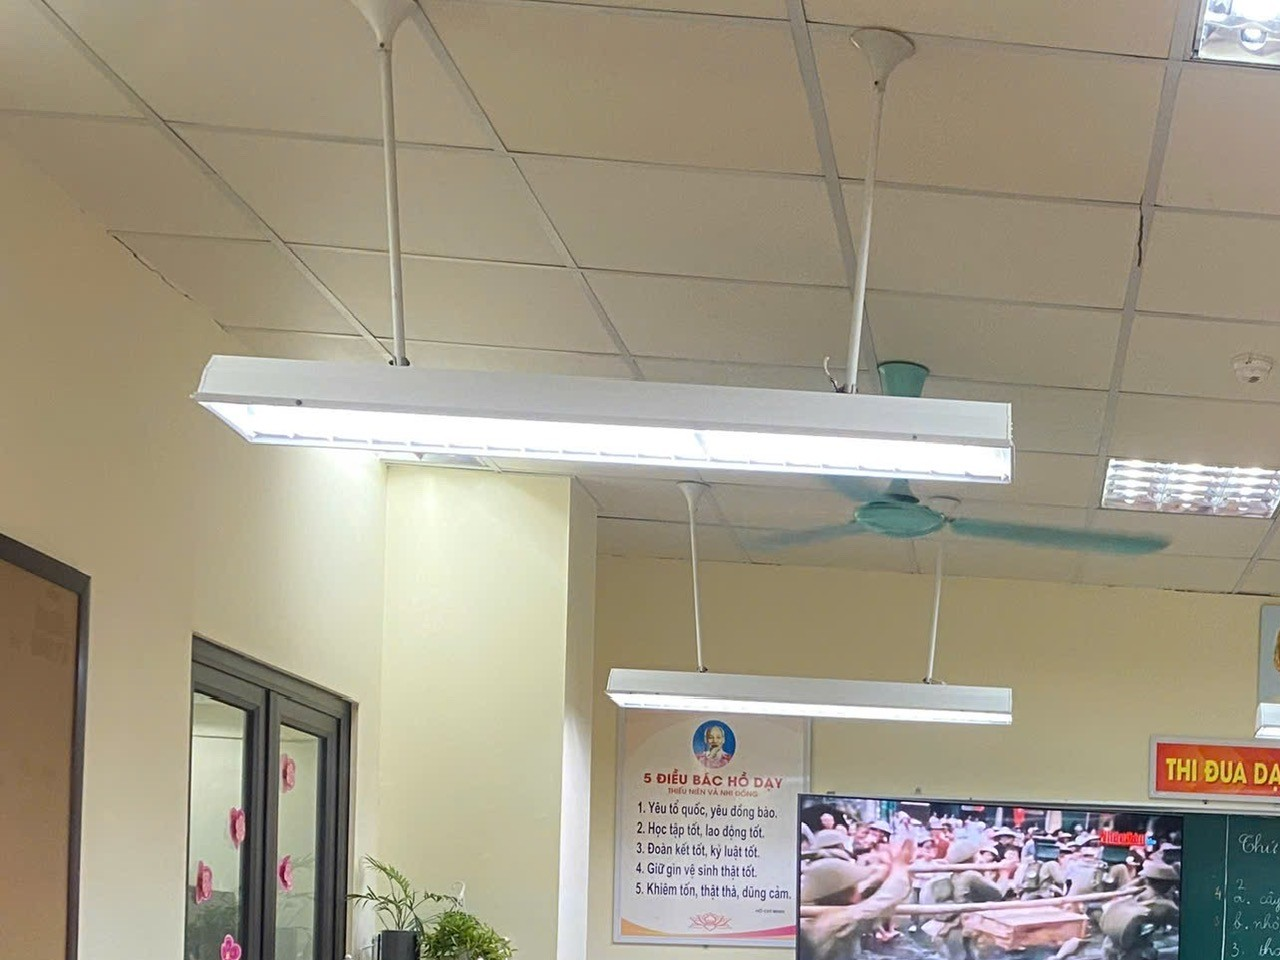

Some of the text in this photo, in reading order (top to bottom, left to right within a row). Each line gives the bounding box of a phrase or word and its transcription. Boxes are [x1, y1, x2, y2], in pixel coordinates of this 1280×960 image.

[1166, 758, 1197, 782] THI
[1204, 759, 1247, 784] ĐUA
[643, 773, 651, 784] 5
[692, 772, 723, 787] BÁC
[754, 777, 783, 792] DẠY
[638, 801, 646, 814] 1.
[649, 801, 667, 814] Yêu
[681, 802, 708, 818] quốc,
[710, 804, 728, 819] yêu
[636, 821, 765, 840] 2. Học tập tốt, lao động tốt.
[636, 842, 644, 854] 3.
[647, 842, 673, 855] Đoàn
[676, 843, 690, 855] kết
[692, 843, 708, 858] tốt,
[724, 844, 742, 860] luật
[744, 844, 760, 859] tốt.
[636, 862, 644, 874] 4.
[647, 862, 665, 875] Giữ
[685, 863, 695, 879] vệ
[698, 864, 719, 877] sinh
[721, 865, 740, 880] thật
[742, 864, 757, 878] tốt.
[635, 882, 644, 895] 5.
[647, 882, 677, 896] Khiêm
[680, 881, 698, 898] tốn,
[701, 884, 719, 900] thật
[742, 886, 766, 901] dũng
[769, 885, 792, 900] cảm.
